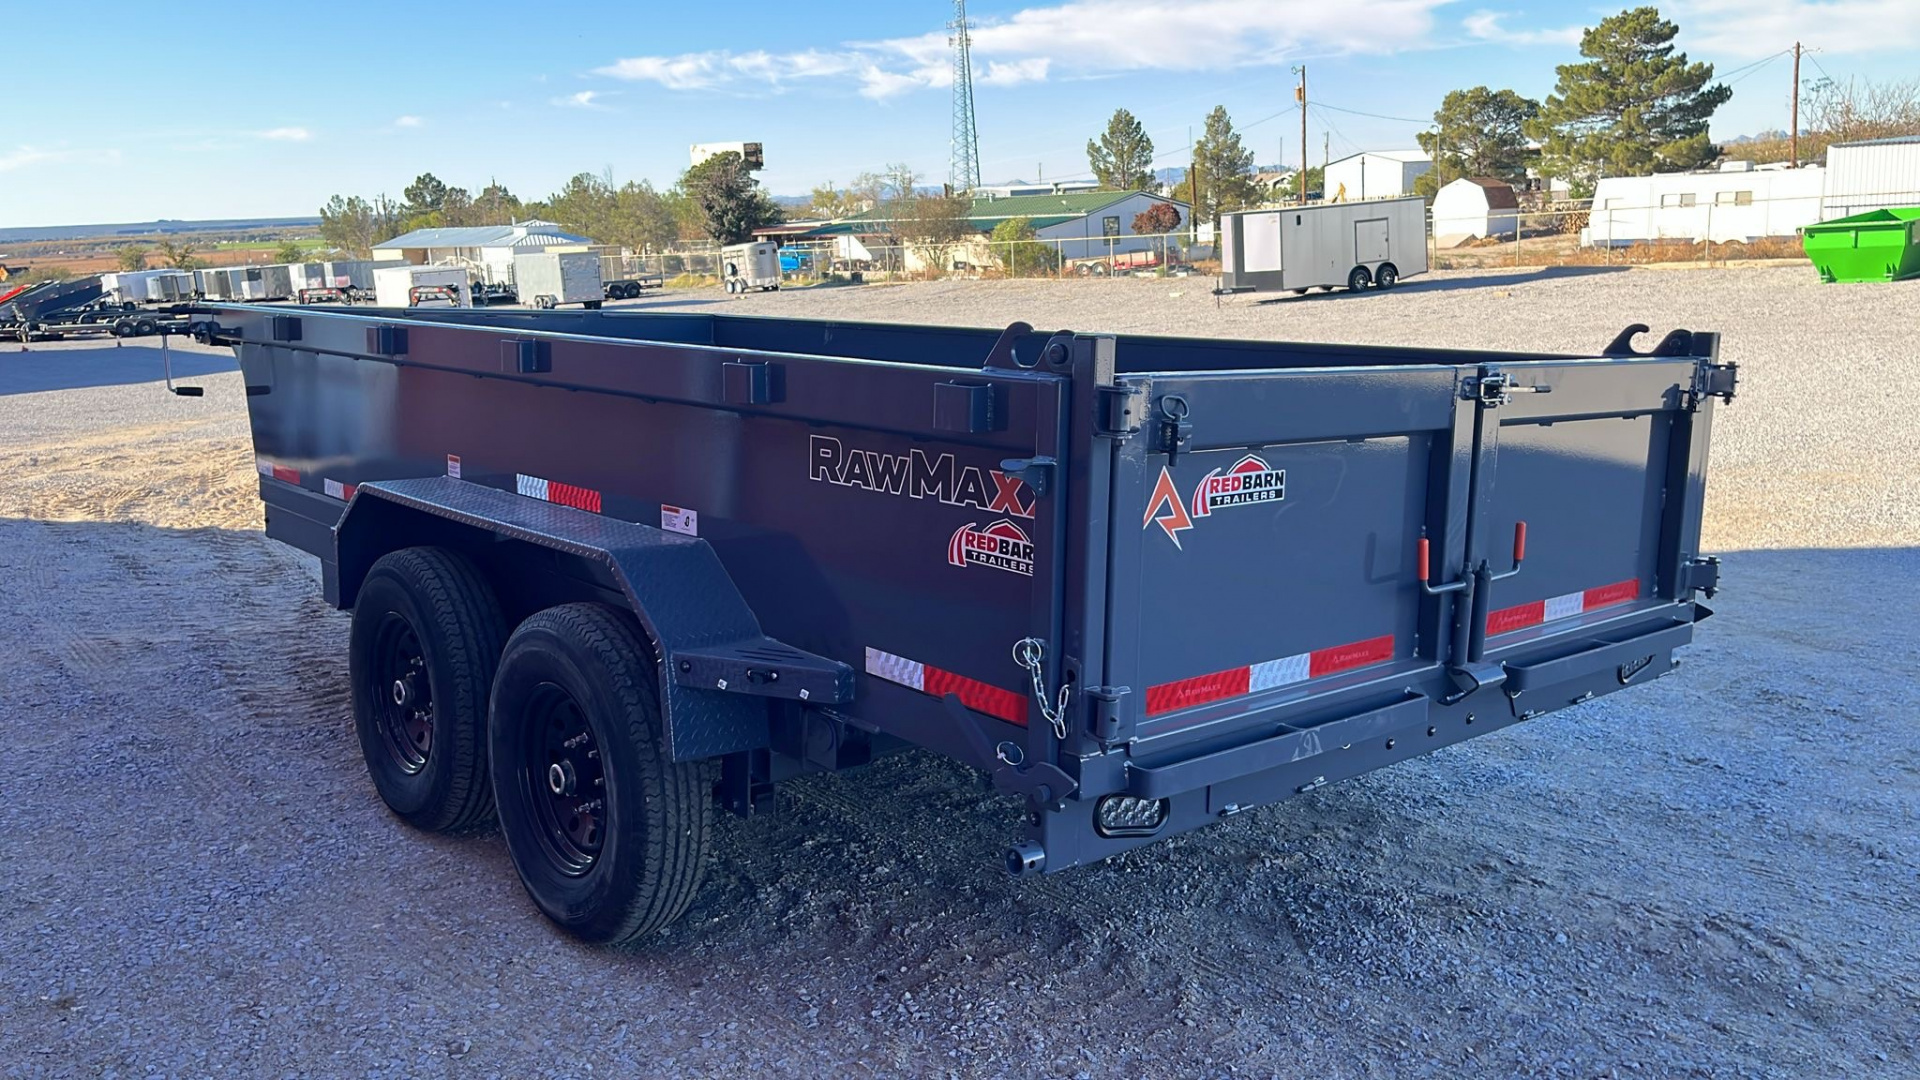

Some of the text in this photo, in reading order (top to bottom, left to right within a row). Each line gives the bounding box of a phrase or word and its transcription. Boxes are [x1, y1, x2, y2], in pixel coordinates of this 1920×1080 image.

[809, 434, 1035, 519] RAWMAX
[1215, 491, 1276, 505] TRAILERS
[965, 531, 1034, 561] REDBAR
